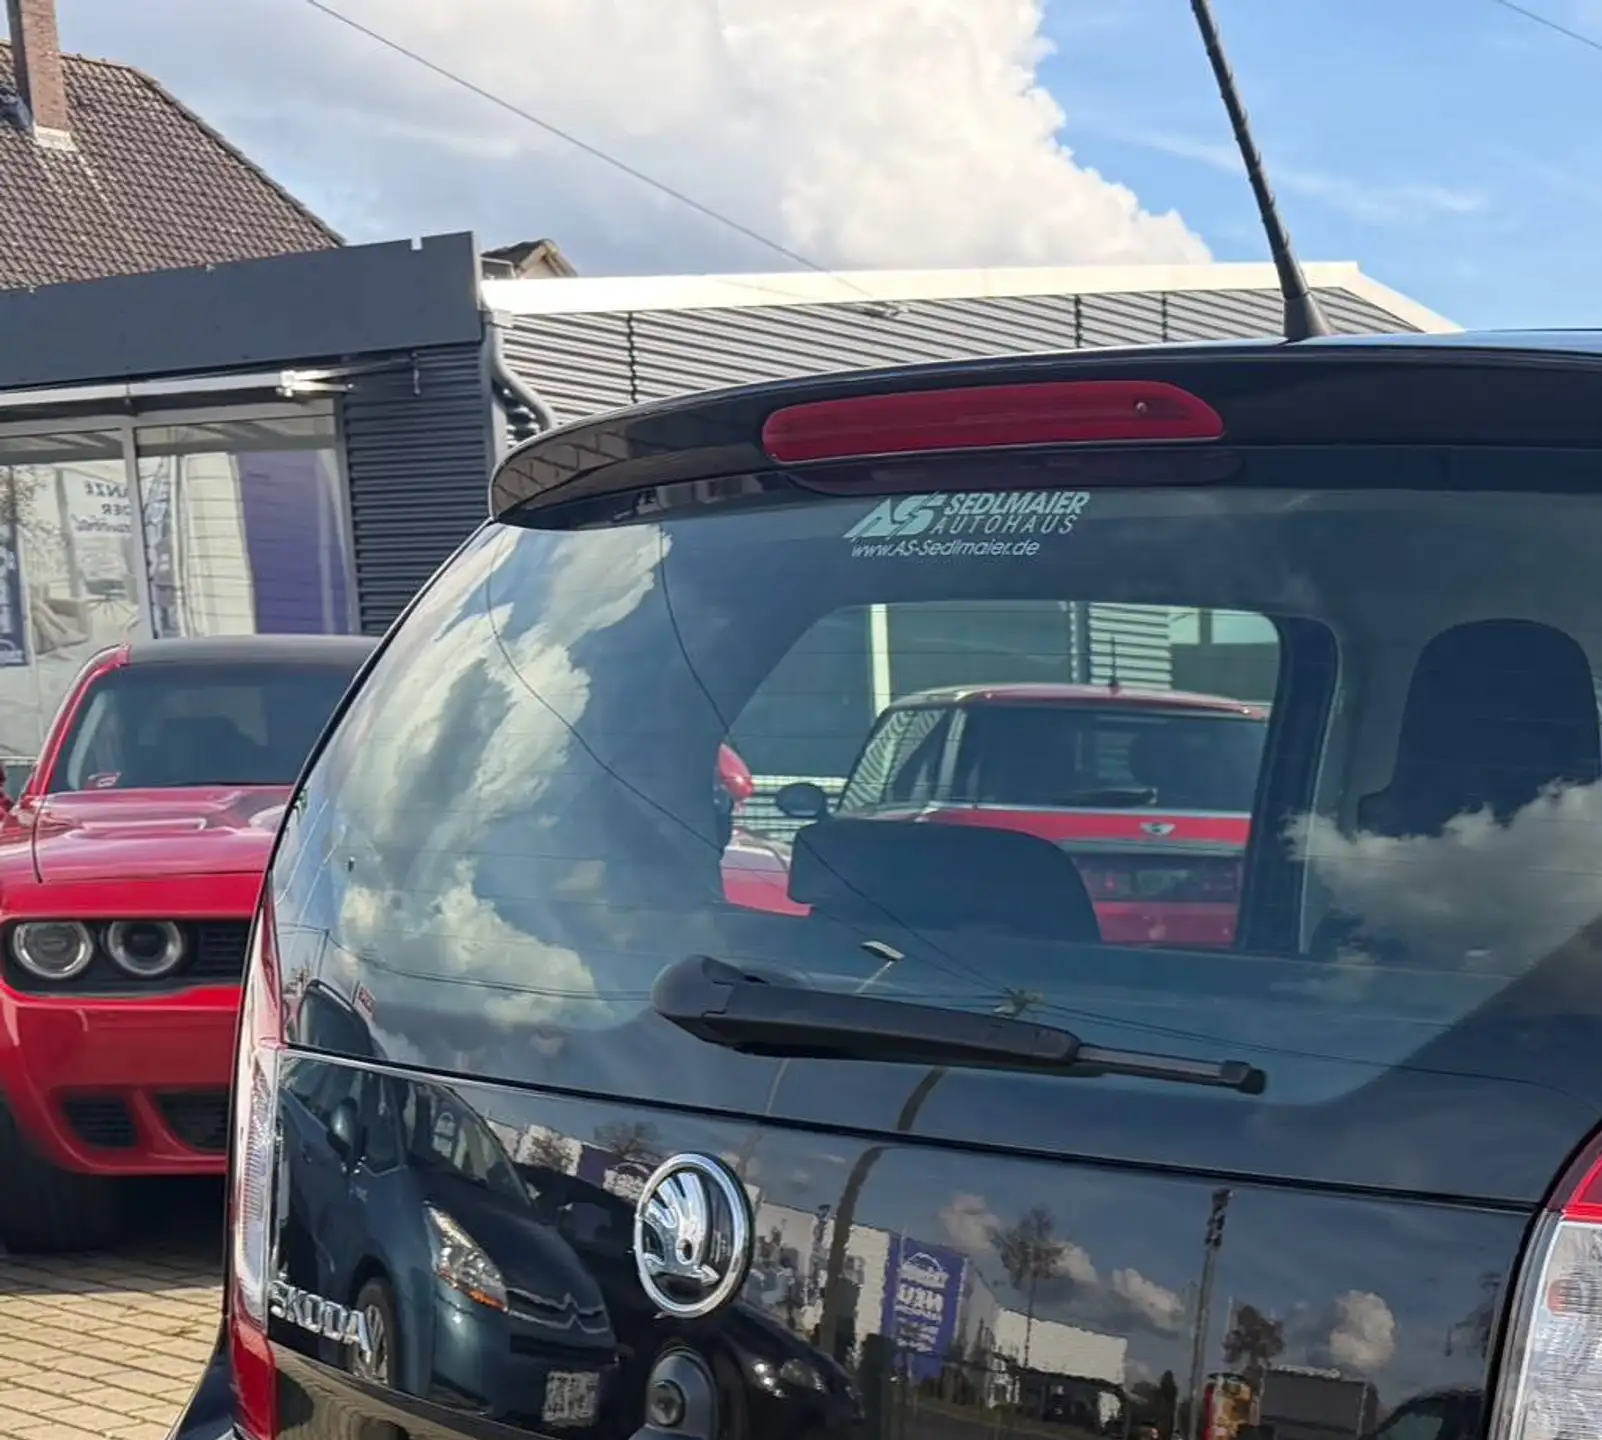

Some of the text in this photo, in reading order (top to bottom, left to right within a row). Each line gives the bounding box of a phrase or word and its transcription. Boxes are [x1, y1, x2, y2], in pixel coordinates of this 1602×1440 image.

[842, 491, 1091, 541] AS SEDLMAIER
[930, 515, 1078, 536] AUTOHAUS
[851, 538, 1041, 558] www.AS-Sedlmaier.de
